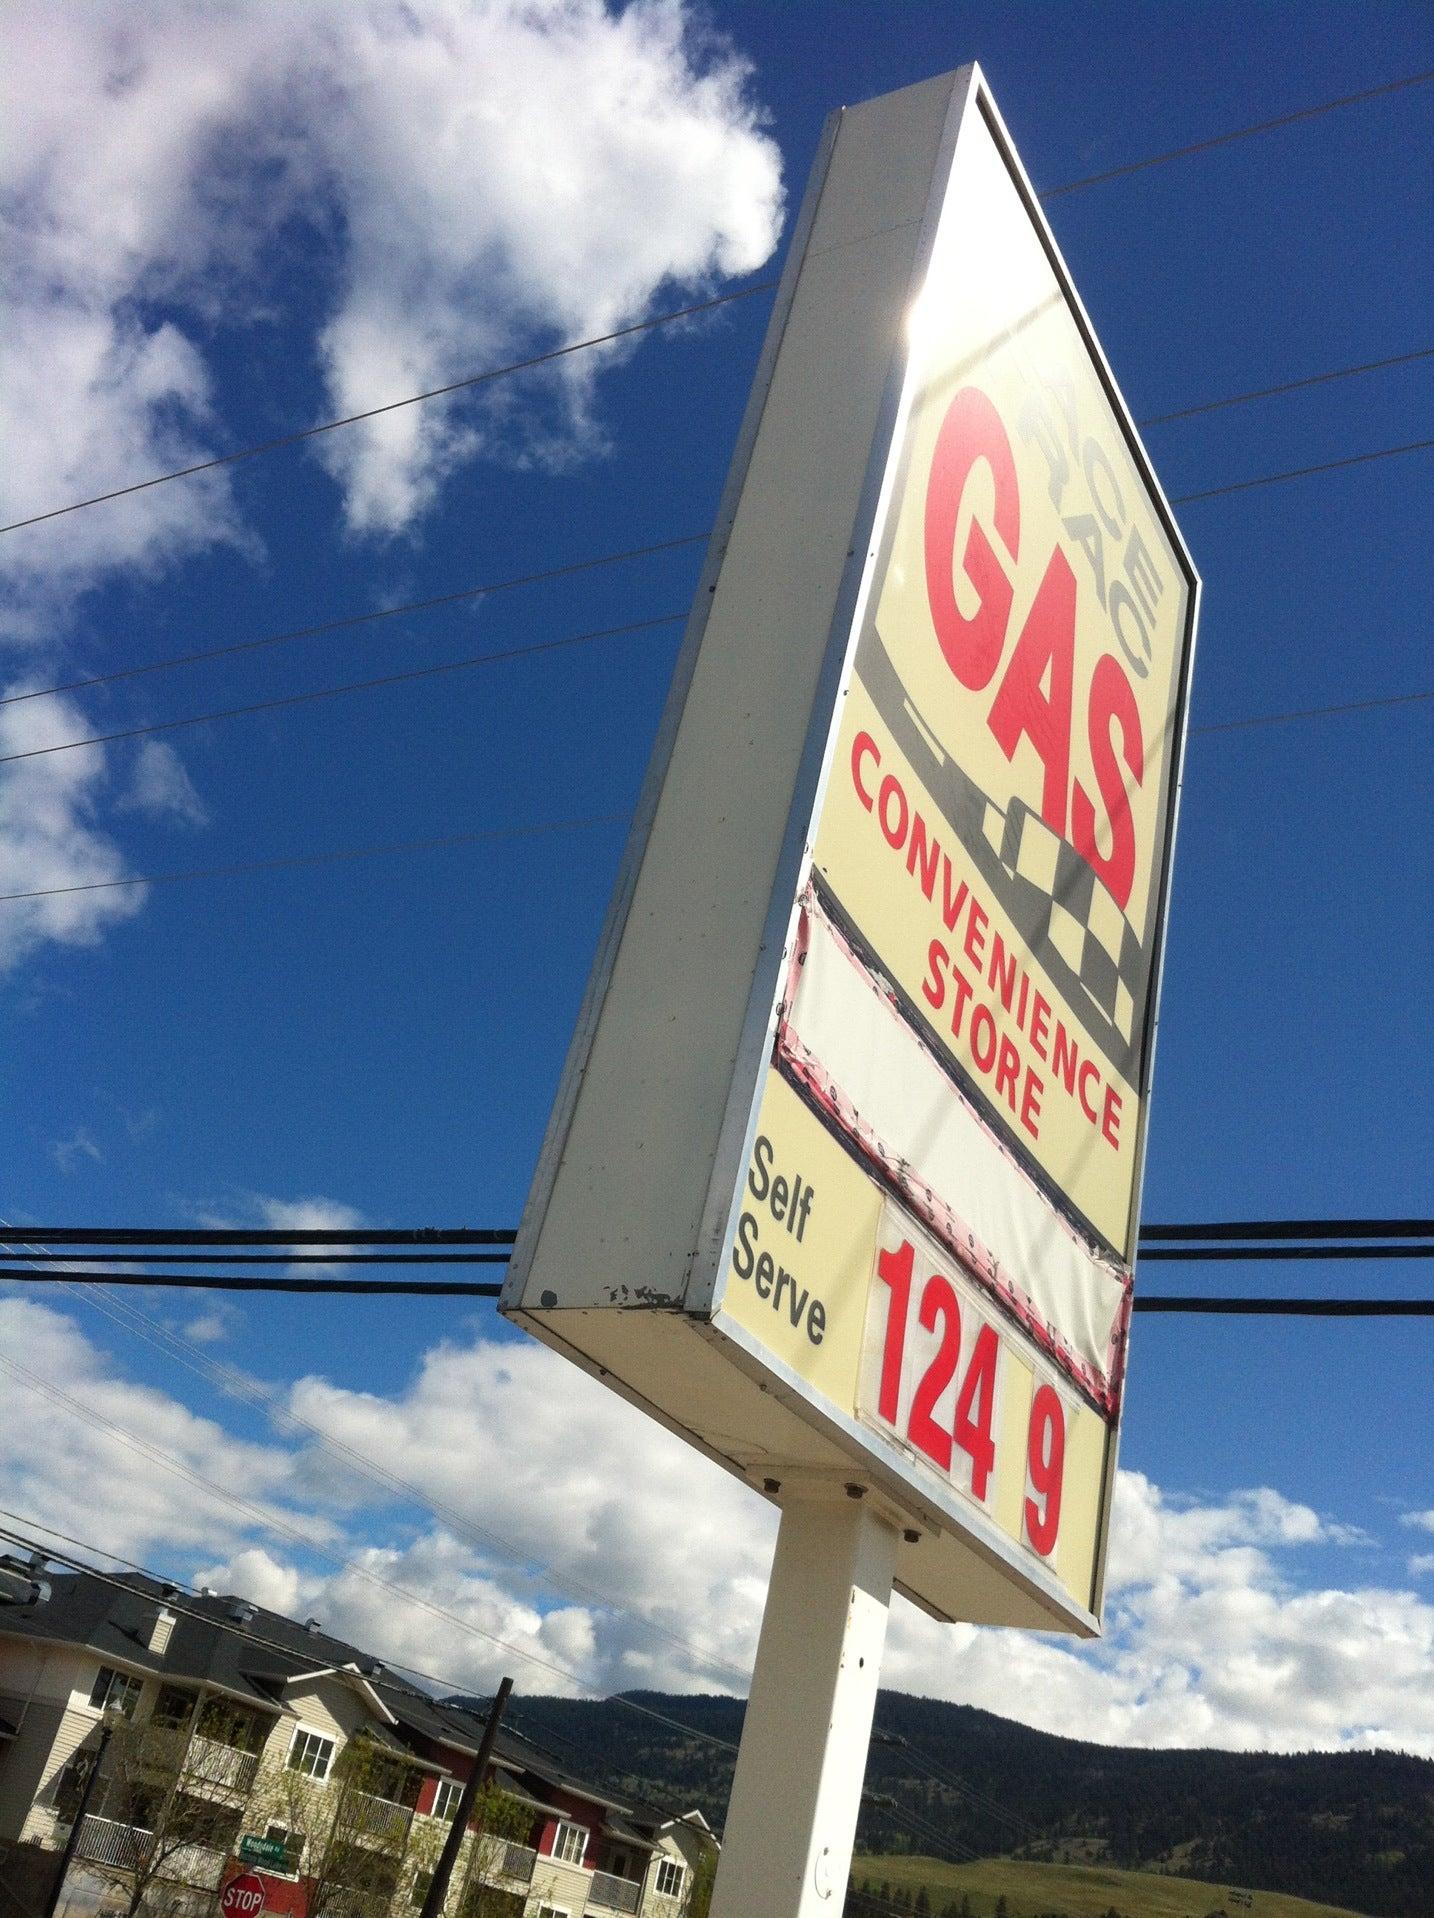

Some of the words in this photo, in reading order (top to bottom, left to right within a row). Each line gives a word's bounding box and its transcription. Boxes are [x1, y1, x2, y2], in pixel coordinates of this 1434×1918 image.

[1032, 350, 1164, 631] ACE
[924, 386, 1143, 910] GAS
[851, 731, 1123, 1151] CONVENIENCE
[922, 938, 1045, 1140] STORE
[732, 1213, 826, 1346] Serve
[748, 1135, 814, 1243] Self
[1024, 1384, 1066, 1556] 9
[224, 1888, 261, 1911] STOP
